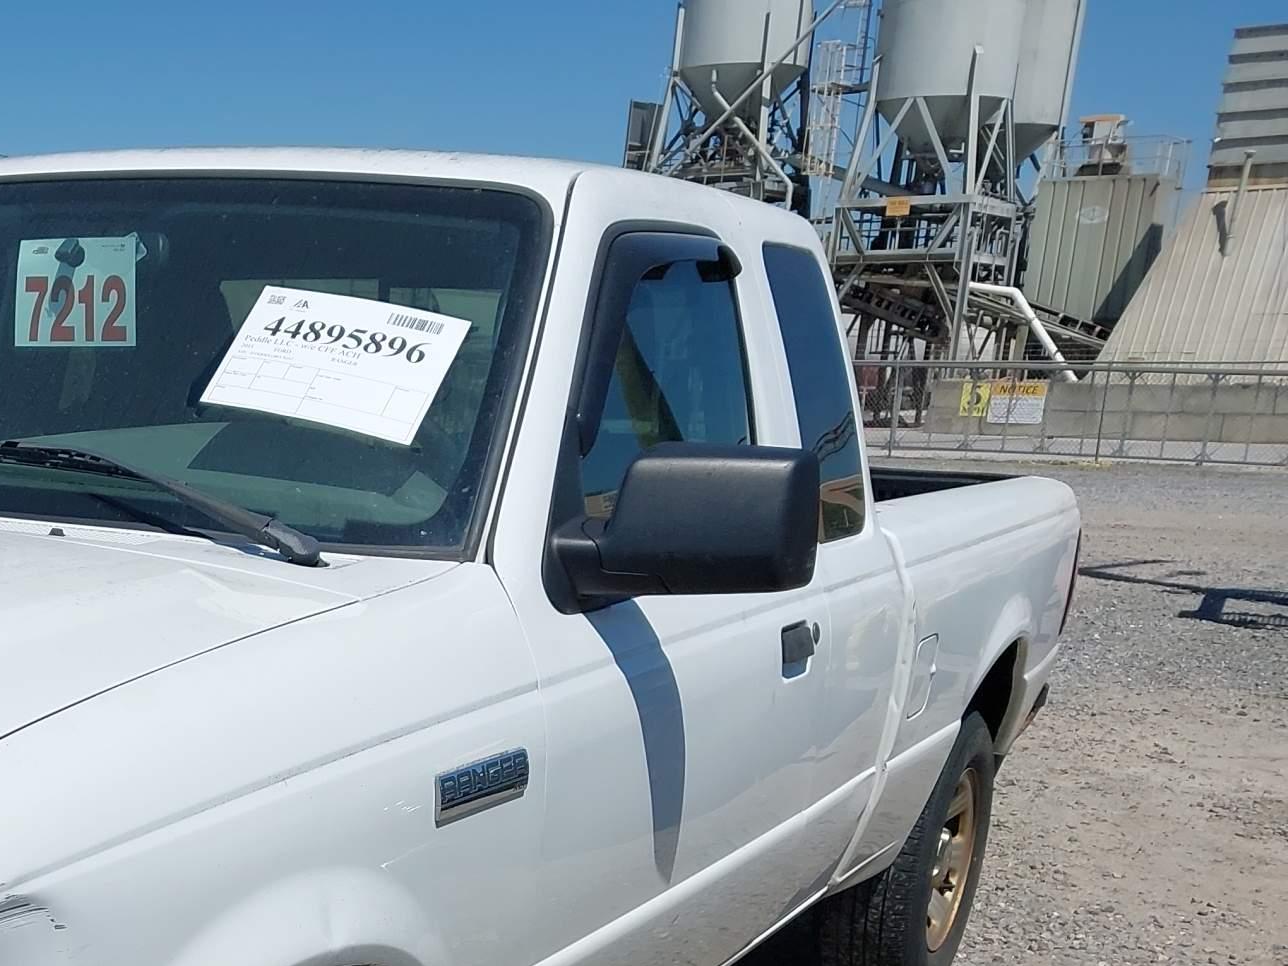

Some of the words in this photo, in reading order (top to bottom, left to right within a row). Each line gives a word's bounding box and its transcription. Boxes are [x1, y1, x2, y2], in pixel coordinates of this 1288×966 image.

[25, 274, 127, 342] 7212
[264, 316, 432, 364] 44895896
[440, 753, 526, 804] RANGER
